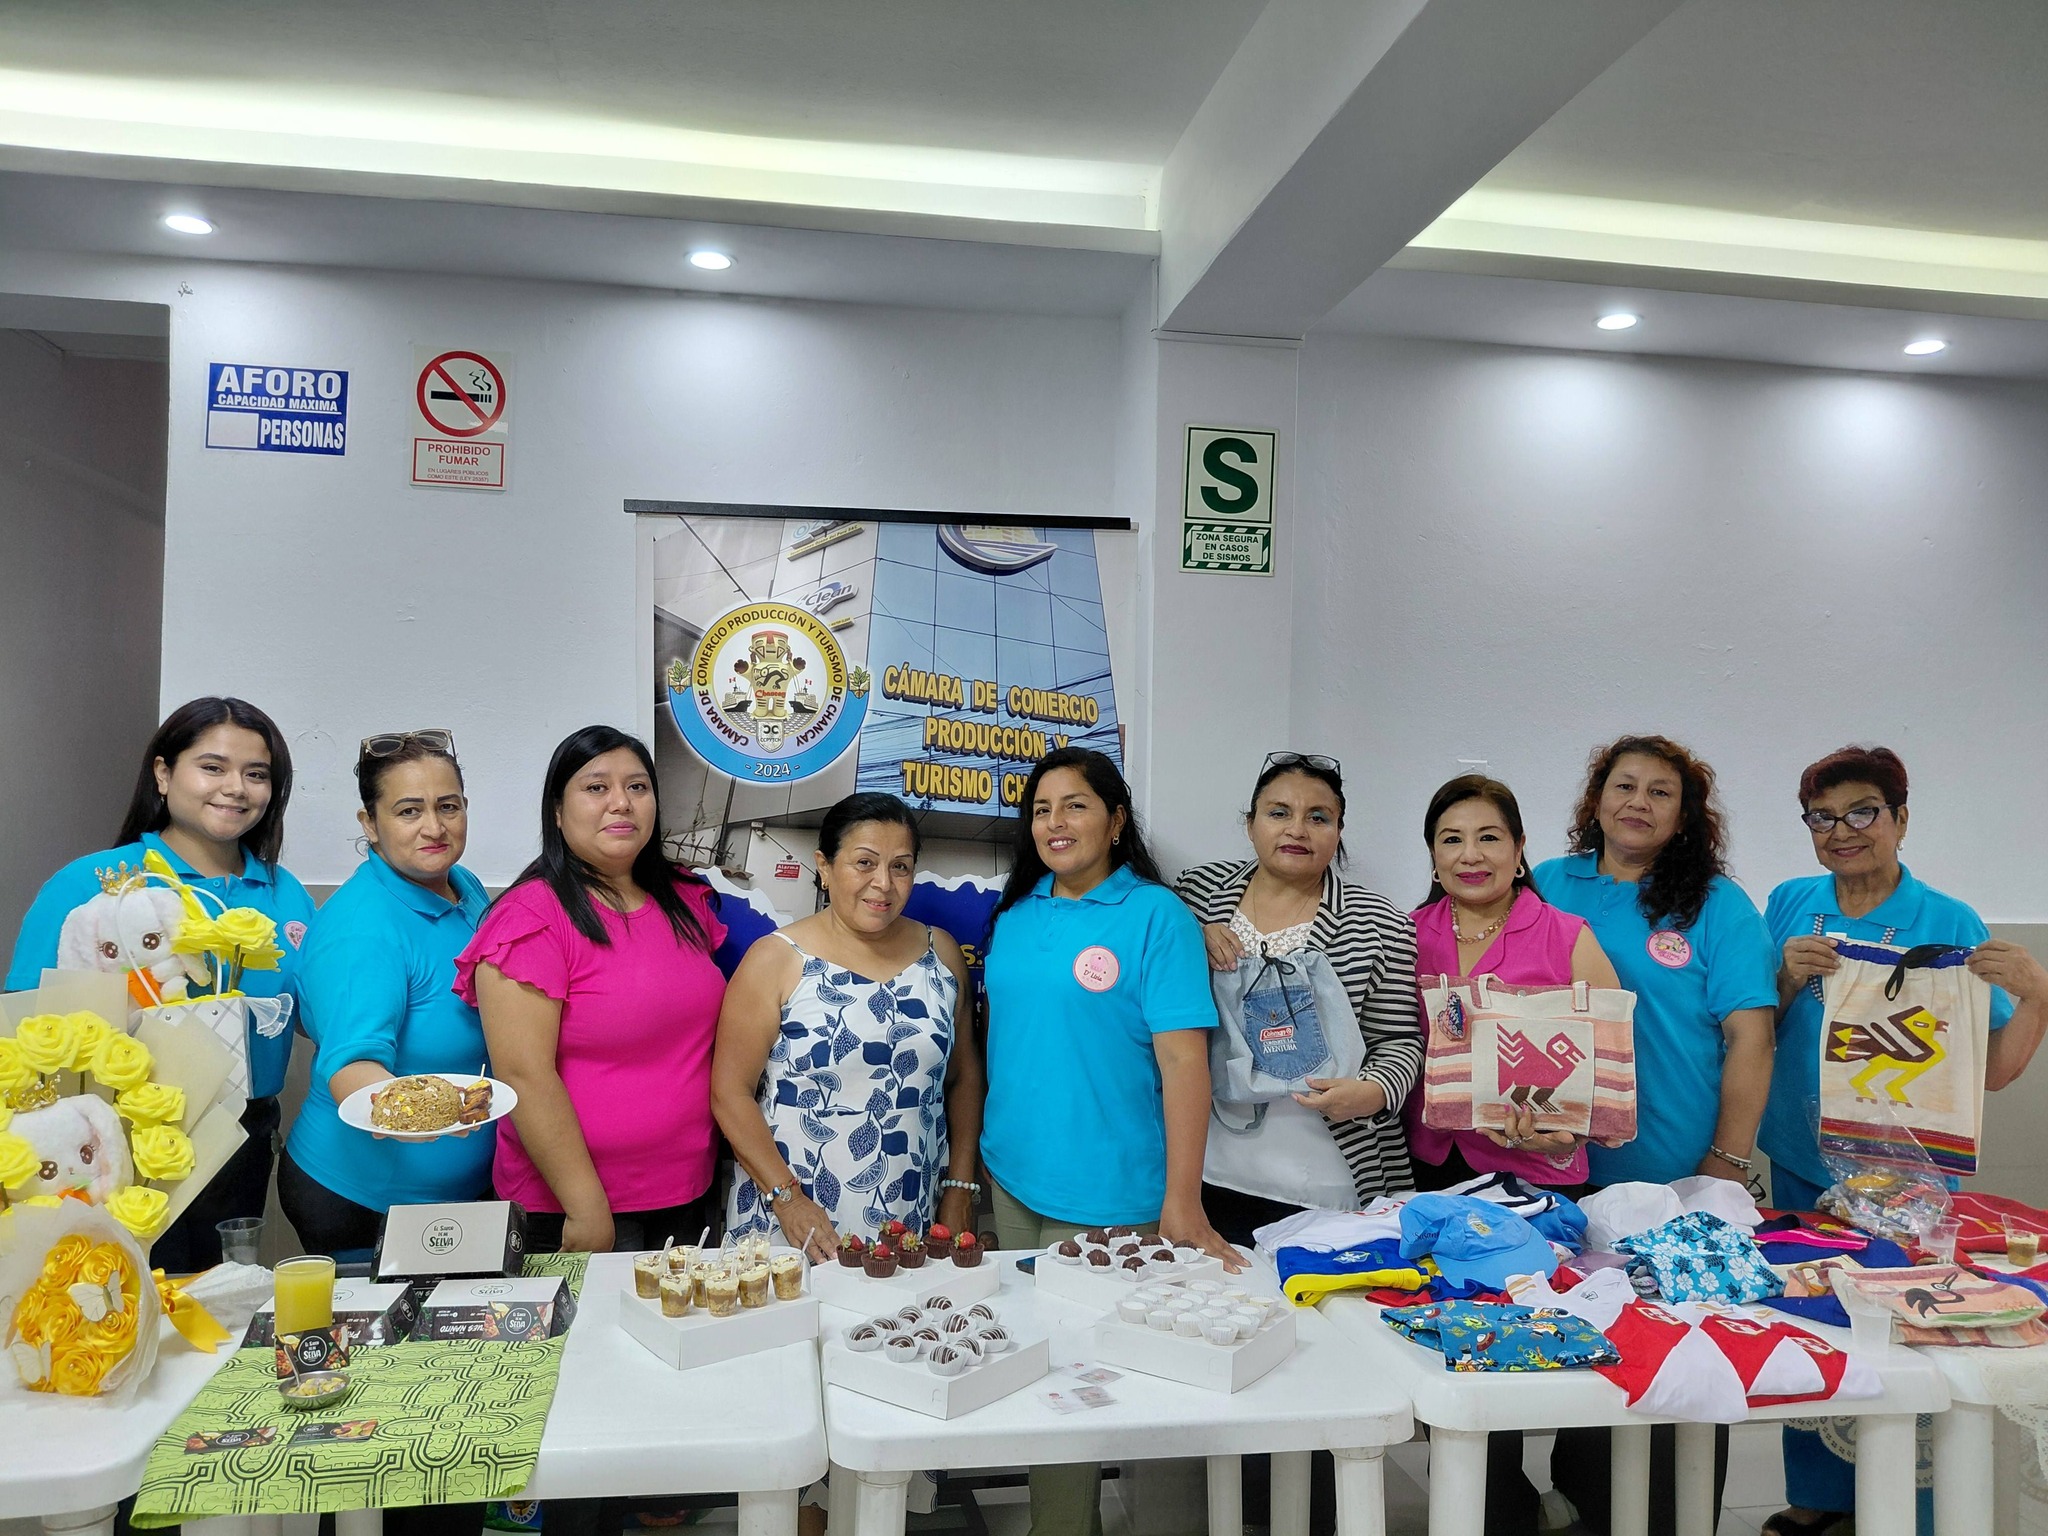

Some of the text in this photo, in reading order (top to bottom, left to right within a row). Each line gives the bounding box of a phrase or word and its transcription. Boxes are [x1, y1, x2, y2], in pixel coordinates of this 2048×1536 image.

[216, 366, 341, 399] AFORO
[218, 394, 338, 411] CAPACIDAD MAXIMA
[260, 418, 344, 449] PERSONAS
[428, 443, 491, 456] PROHIBIDO
[439, 455, 479, 466] FUMAR
[1200, 437, 1259, 514] S
[1196, 533, 1259, 544] ZONA SEGURA
[1205, 543, 1249, 553] EN CASOS
[1217, 553, 1251, 562] SISMOS
[697, 609, 843, 747] CÁMARA DE COMERCIO PRODUCCIÓN Y TURISMO DE CHANCAY
[883, 662, 1099, 727] CÁMARA DE COMERCIO
[923, 717, 1046, 761] PRODUCCIÓN
[753, 761, 791, 778] 2024
[902, 761, 1028, 806] TURISMO CH
[1263, 1044, 1298, 1054] AVENTURA
[429, 1236, 454, 1247] SELVA
